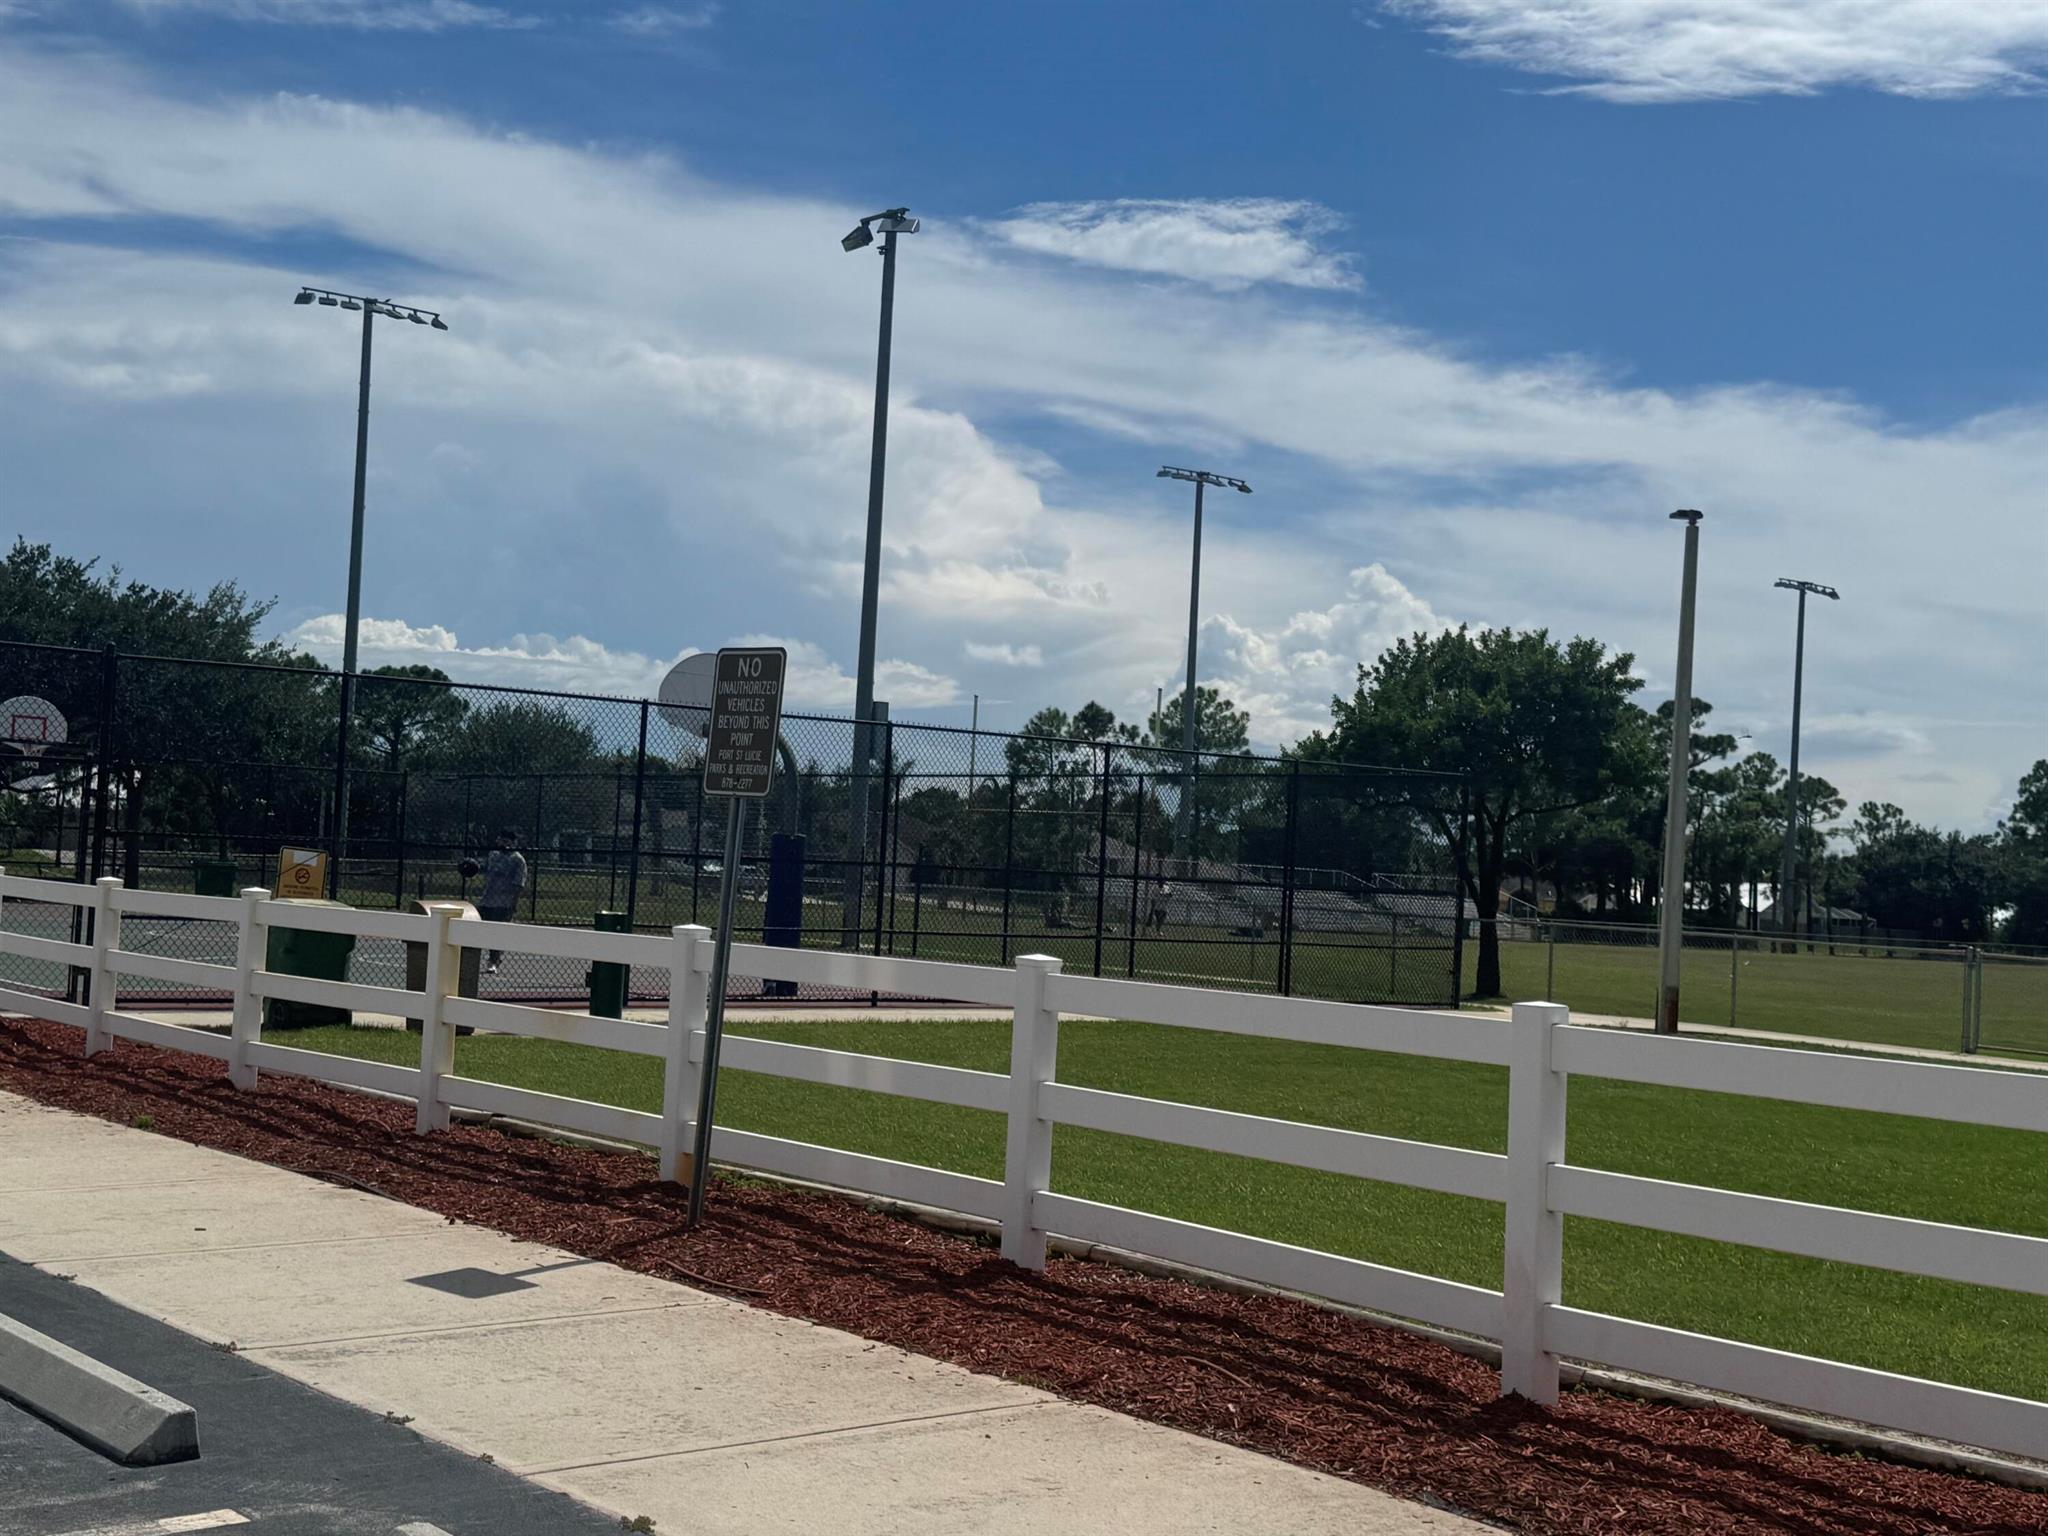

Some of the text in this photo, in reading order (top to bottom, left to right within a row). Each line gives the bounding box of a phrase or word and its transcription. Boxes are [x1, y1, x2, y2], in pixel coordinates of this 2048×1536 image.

[738, 657, 762, 677] NO
[718, 680, 778, 695] UNAUTHORIZED
[727, 698, 765, 712] VEHICLES
[718, 715, 770, 729] BEYOND THIS
[730, 732, 754, 746] POINT
